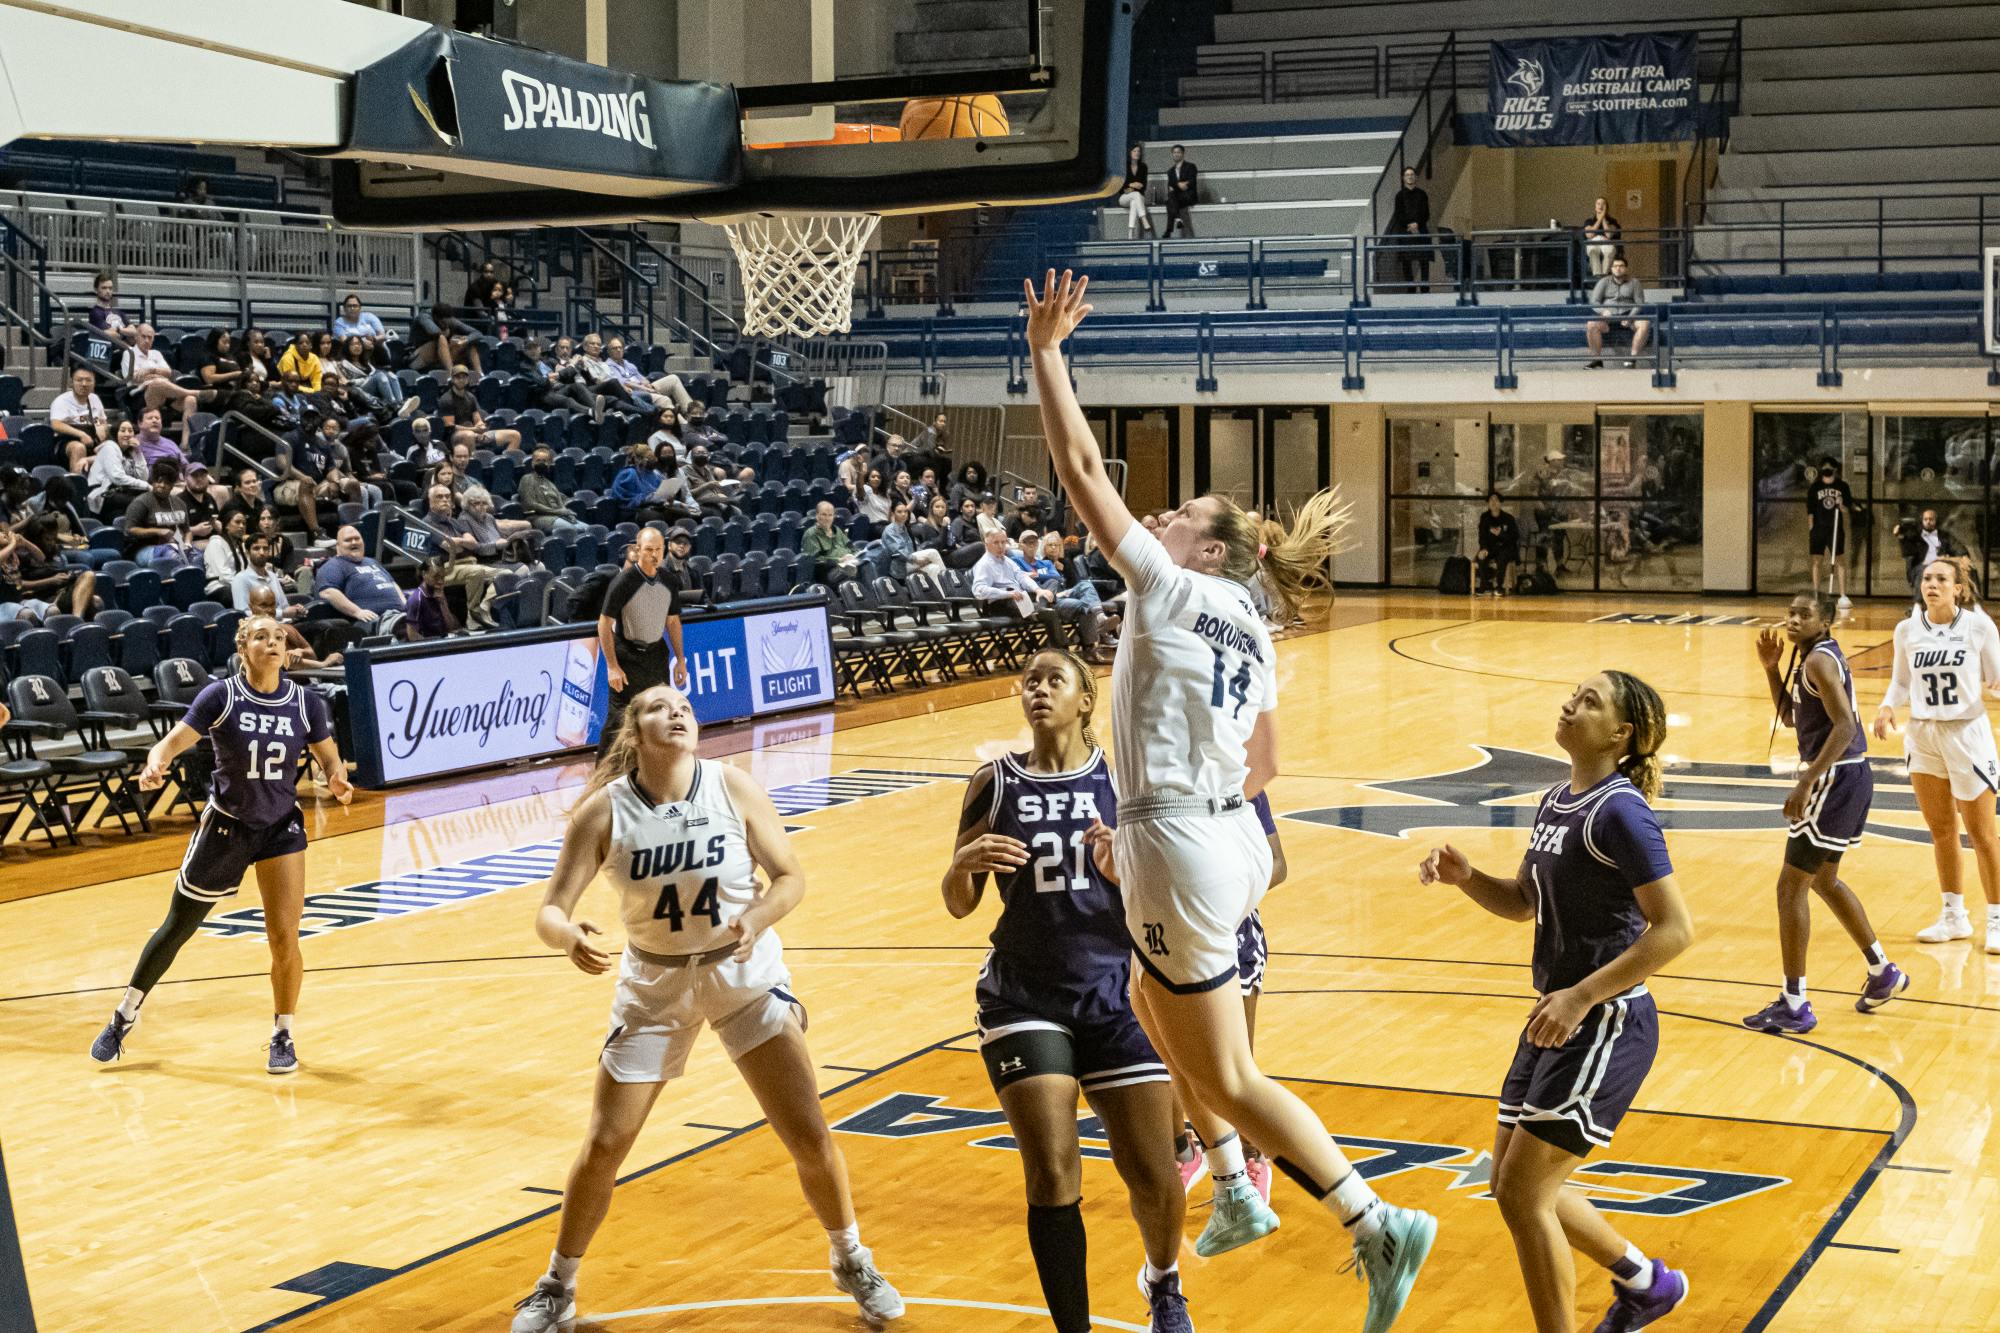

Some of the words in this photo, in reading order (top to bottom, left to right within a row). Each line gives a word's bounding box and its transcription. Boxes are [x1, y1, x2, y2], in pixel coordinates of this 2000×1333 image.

[1562, 79, 1643, 97] BASKETBALL
[1646, 77, 1692, 92] CAMPS
[1590, 67, 1629, 81] SCOTT
[1631, 65, 1665, 79] PERA
[502, 69, 654, 150] SPALDING
[1502, 96, 1550, 113] RICE
[1592, 97, 1688, 111] SCOTTPERA.com
[1494, 113, 1554, 131] OWLS
[89, 343, 107, 360] 102
[772, 354, 787, 366] 103
[405, 531, 426, 550] 102
[669, 647, 736, 697] GHT
[1914, 650, 1966, 668] OWLS
[564, 682, 589, 704] FLIGHT
[768, 674, 812, 696] FLIGHT
[1211, 646, 1251, 720] 14
[1922, 672, 1958, 706] 32
[239, 711, 295, 737] SFA
[388, 670, 552, 759] Yuengling
[246, 739, 287, 780] 12
[1018, 791, 1101, 823] SFA
[1529, 822, 1570, 855] SFA
[630, 834, 726, 881] OWLS
[1031, 830, 1090, 893] 21
[653, 876, 722, 932] 44
[1142, 922, 1170, 956] R
